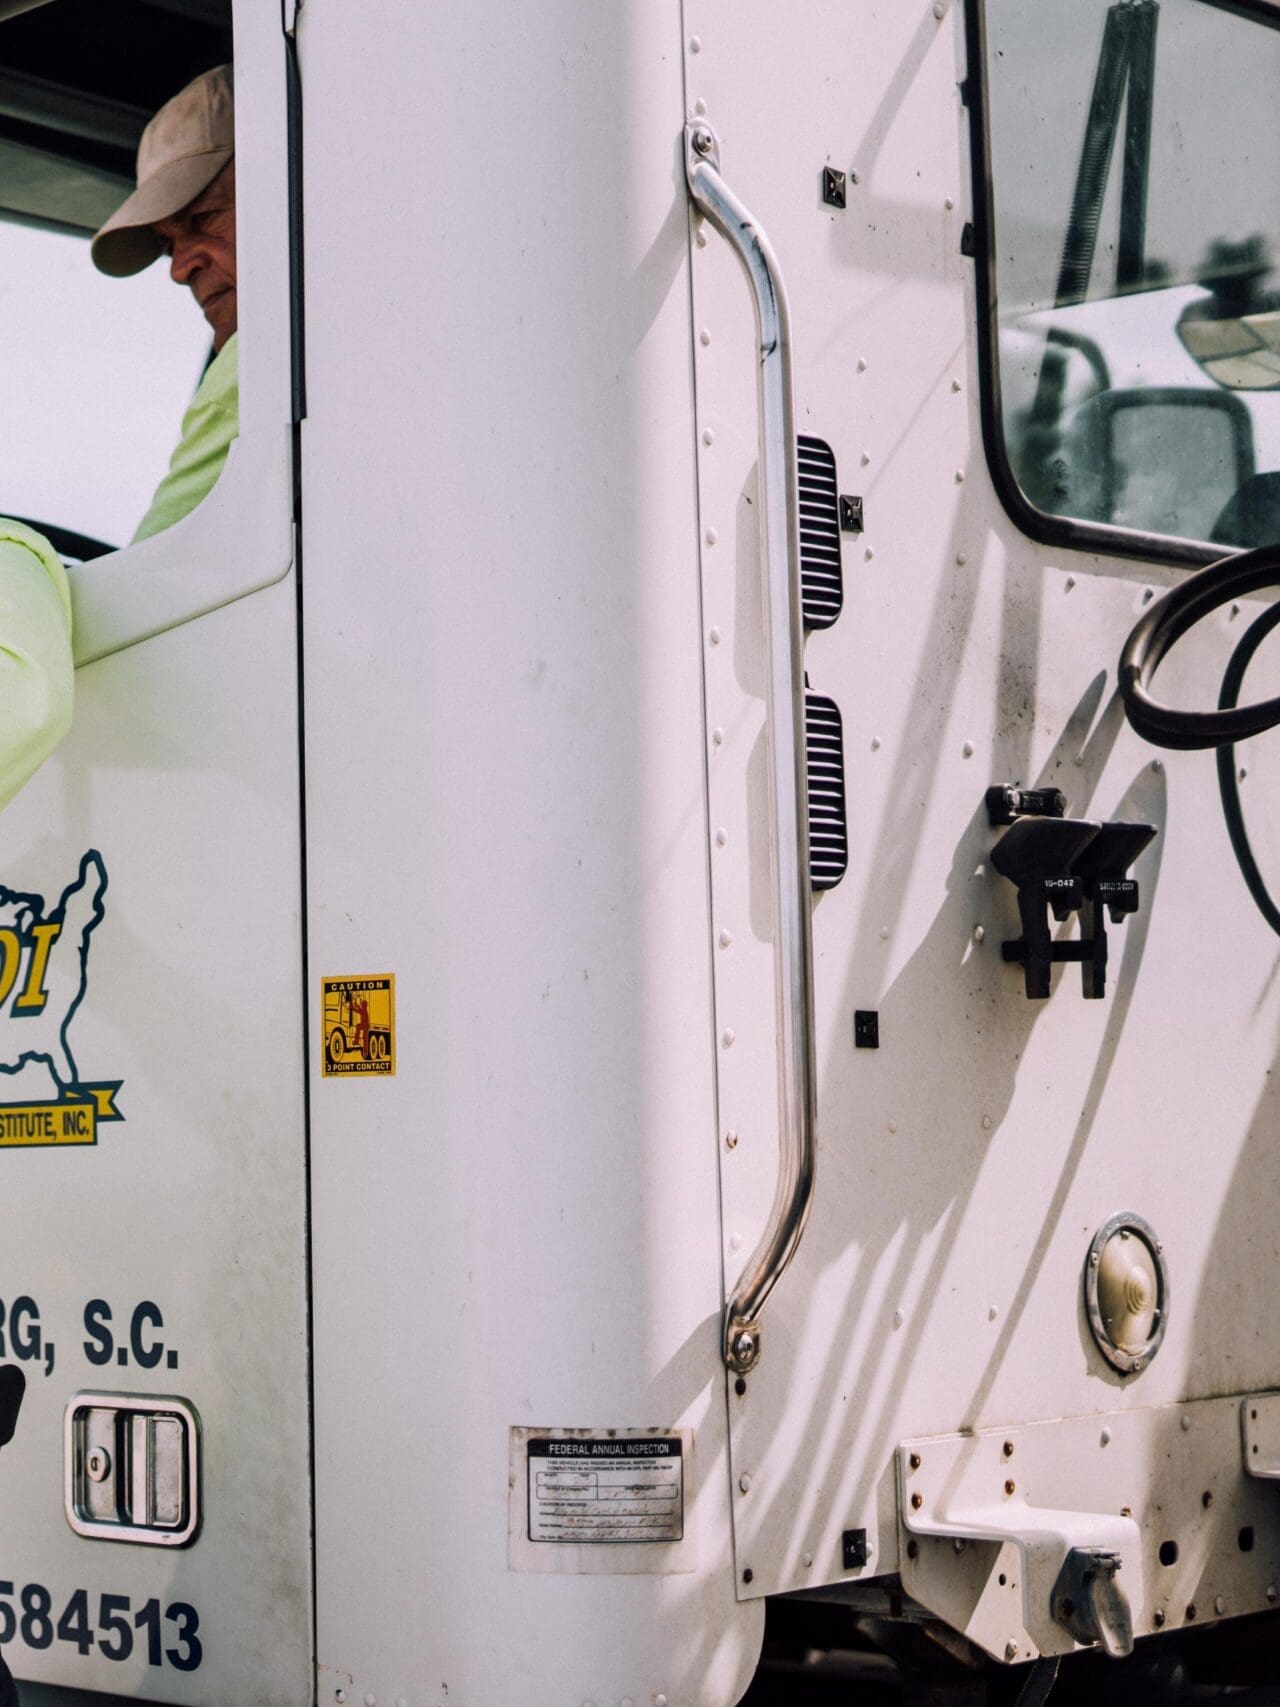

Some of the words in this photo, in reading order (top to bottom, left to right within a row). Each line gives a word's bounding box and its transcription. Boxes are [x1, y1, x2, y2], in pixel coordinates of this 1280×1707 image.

[331, 982, 383, 991] CAUTION
[333, 1063, 355, 1071] POINT
[356, 1062, 390, 1070] CONTACT
[62, 1111, 89, 1136] INC.
[83, 1299, 178, 1369] S.C.
[549, 1444, 590, 1455] FEDERAL
[591, 1444, 626, 1455] ANNUAL
[627, 1443, 670, 1455] INSPECTION
